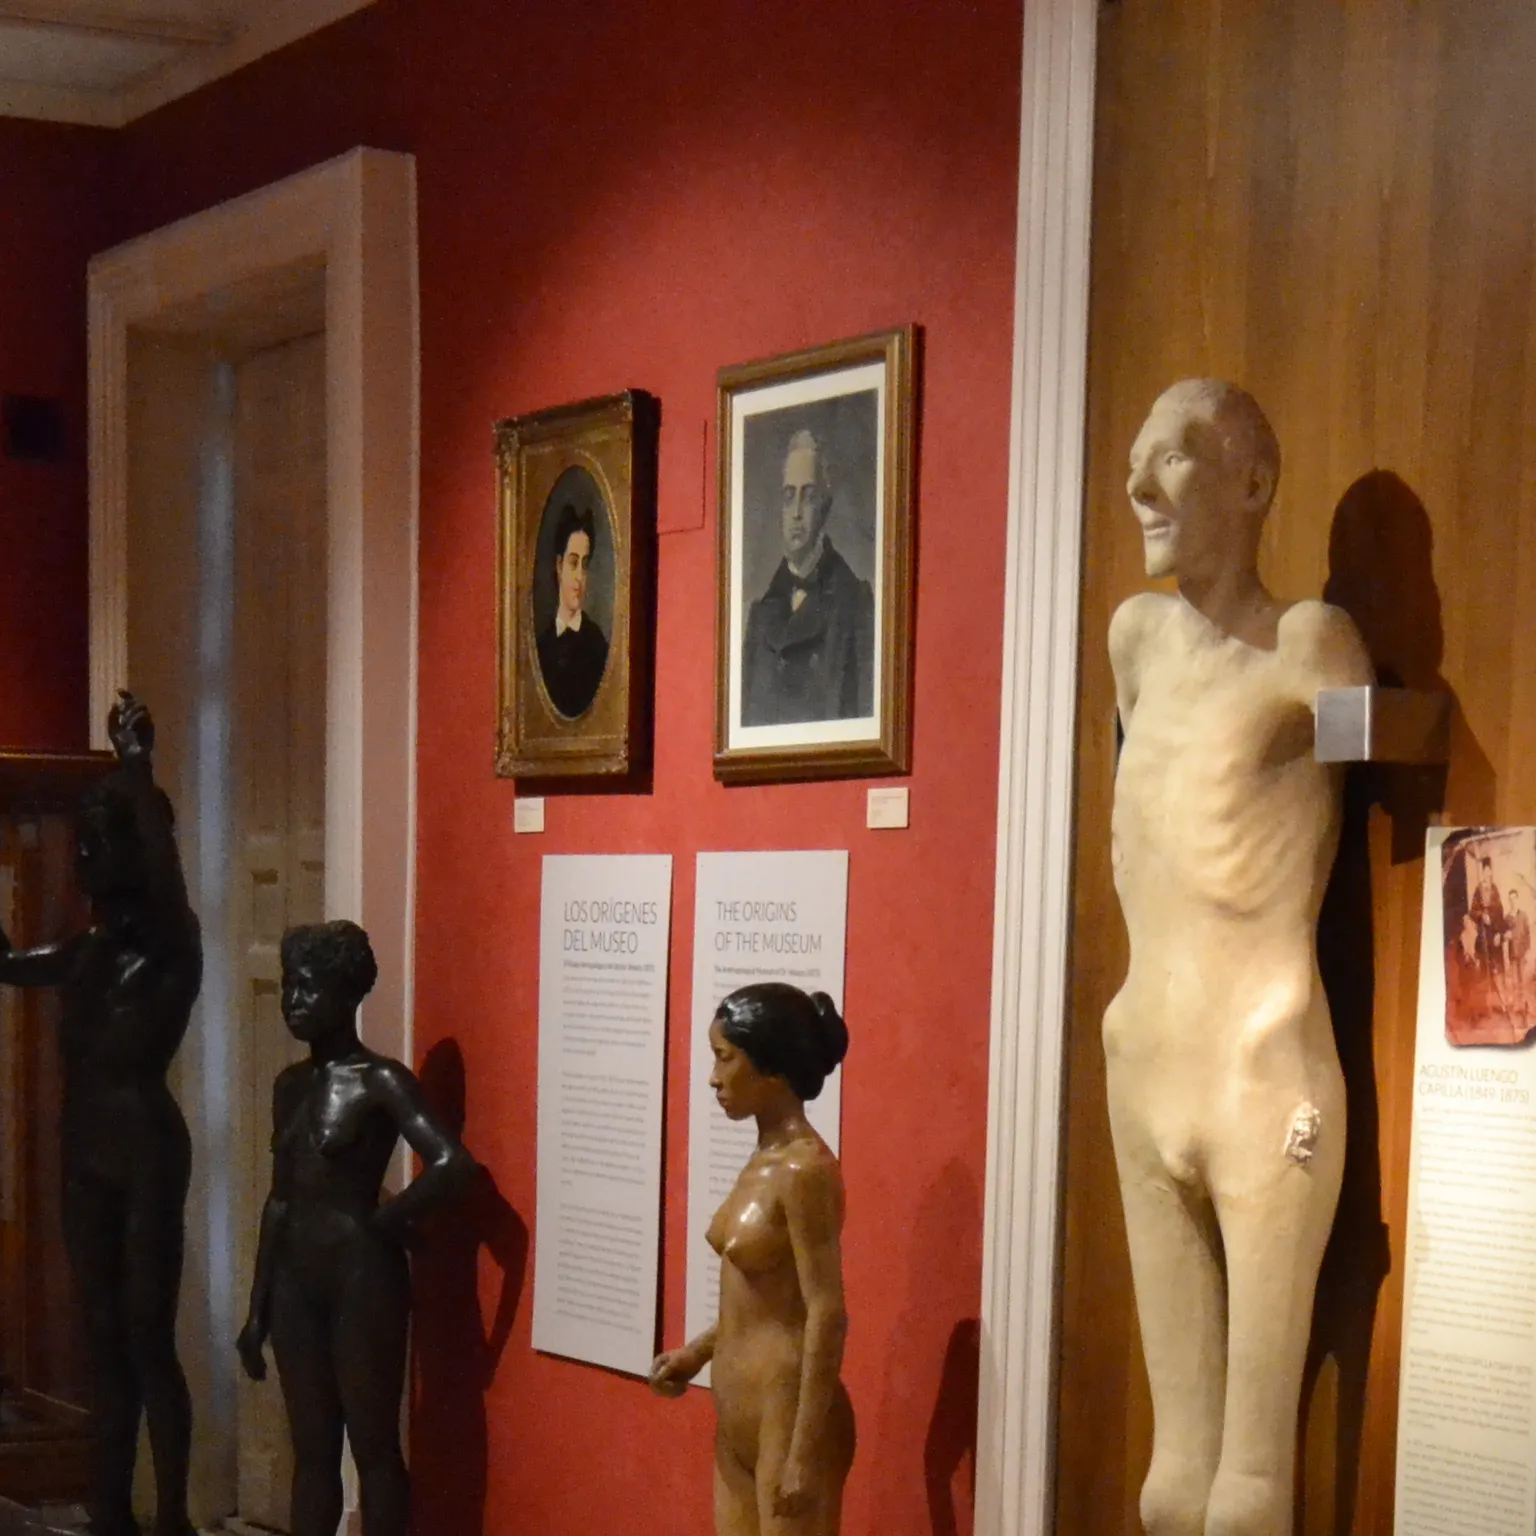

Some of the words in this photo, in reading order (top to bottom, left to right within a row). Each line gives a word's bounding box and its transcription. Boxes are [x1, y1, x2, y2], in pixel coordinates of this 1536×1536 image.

[563, 900, 588, 923] LOS
[590, 896, 658, 925] ORÍGENES
[715, 900, 741, 921] THE
[742, 900, 797, 922] ORIGINS
[563, 928, 588, 951] DEL
[590, 930, 639, 953] MUSEO
[714, 931, 733, 951] OF
[735, 931, 760, 952] THE
[762, 932, 823, 954] MUSEUM
